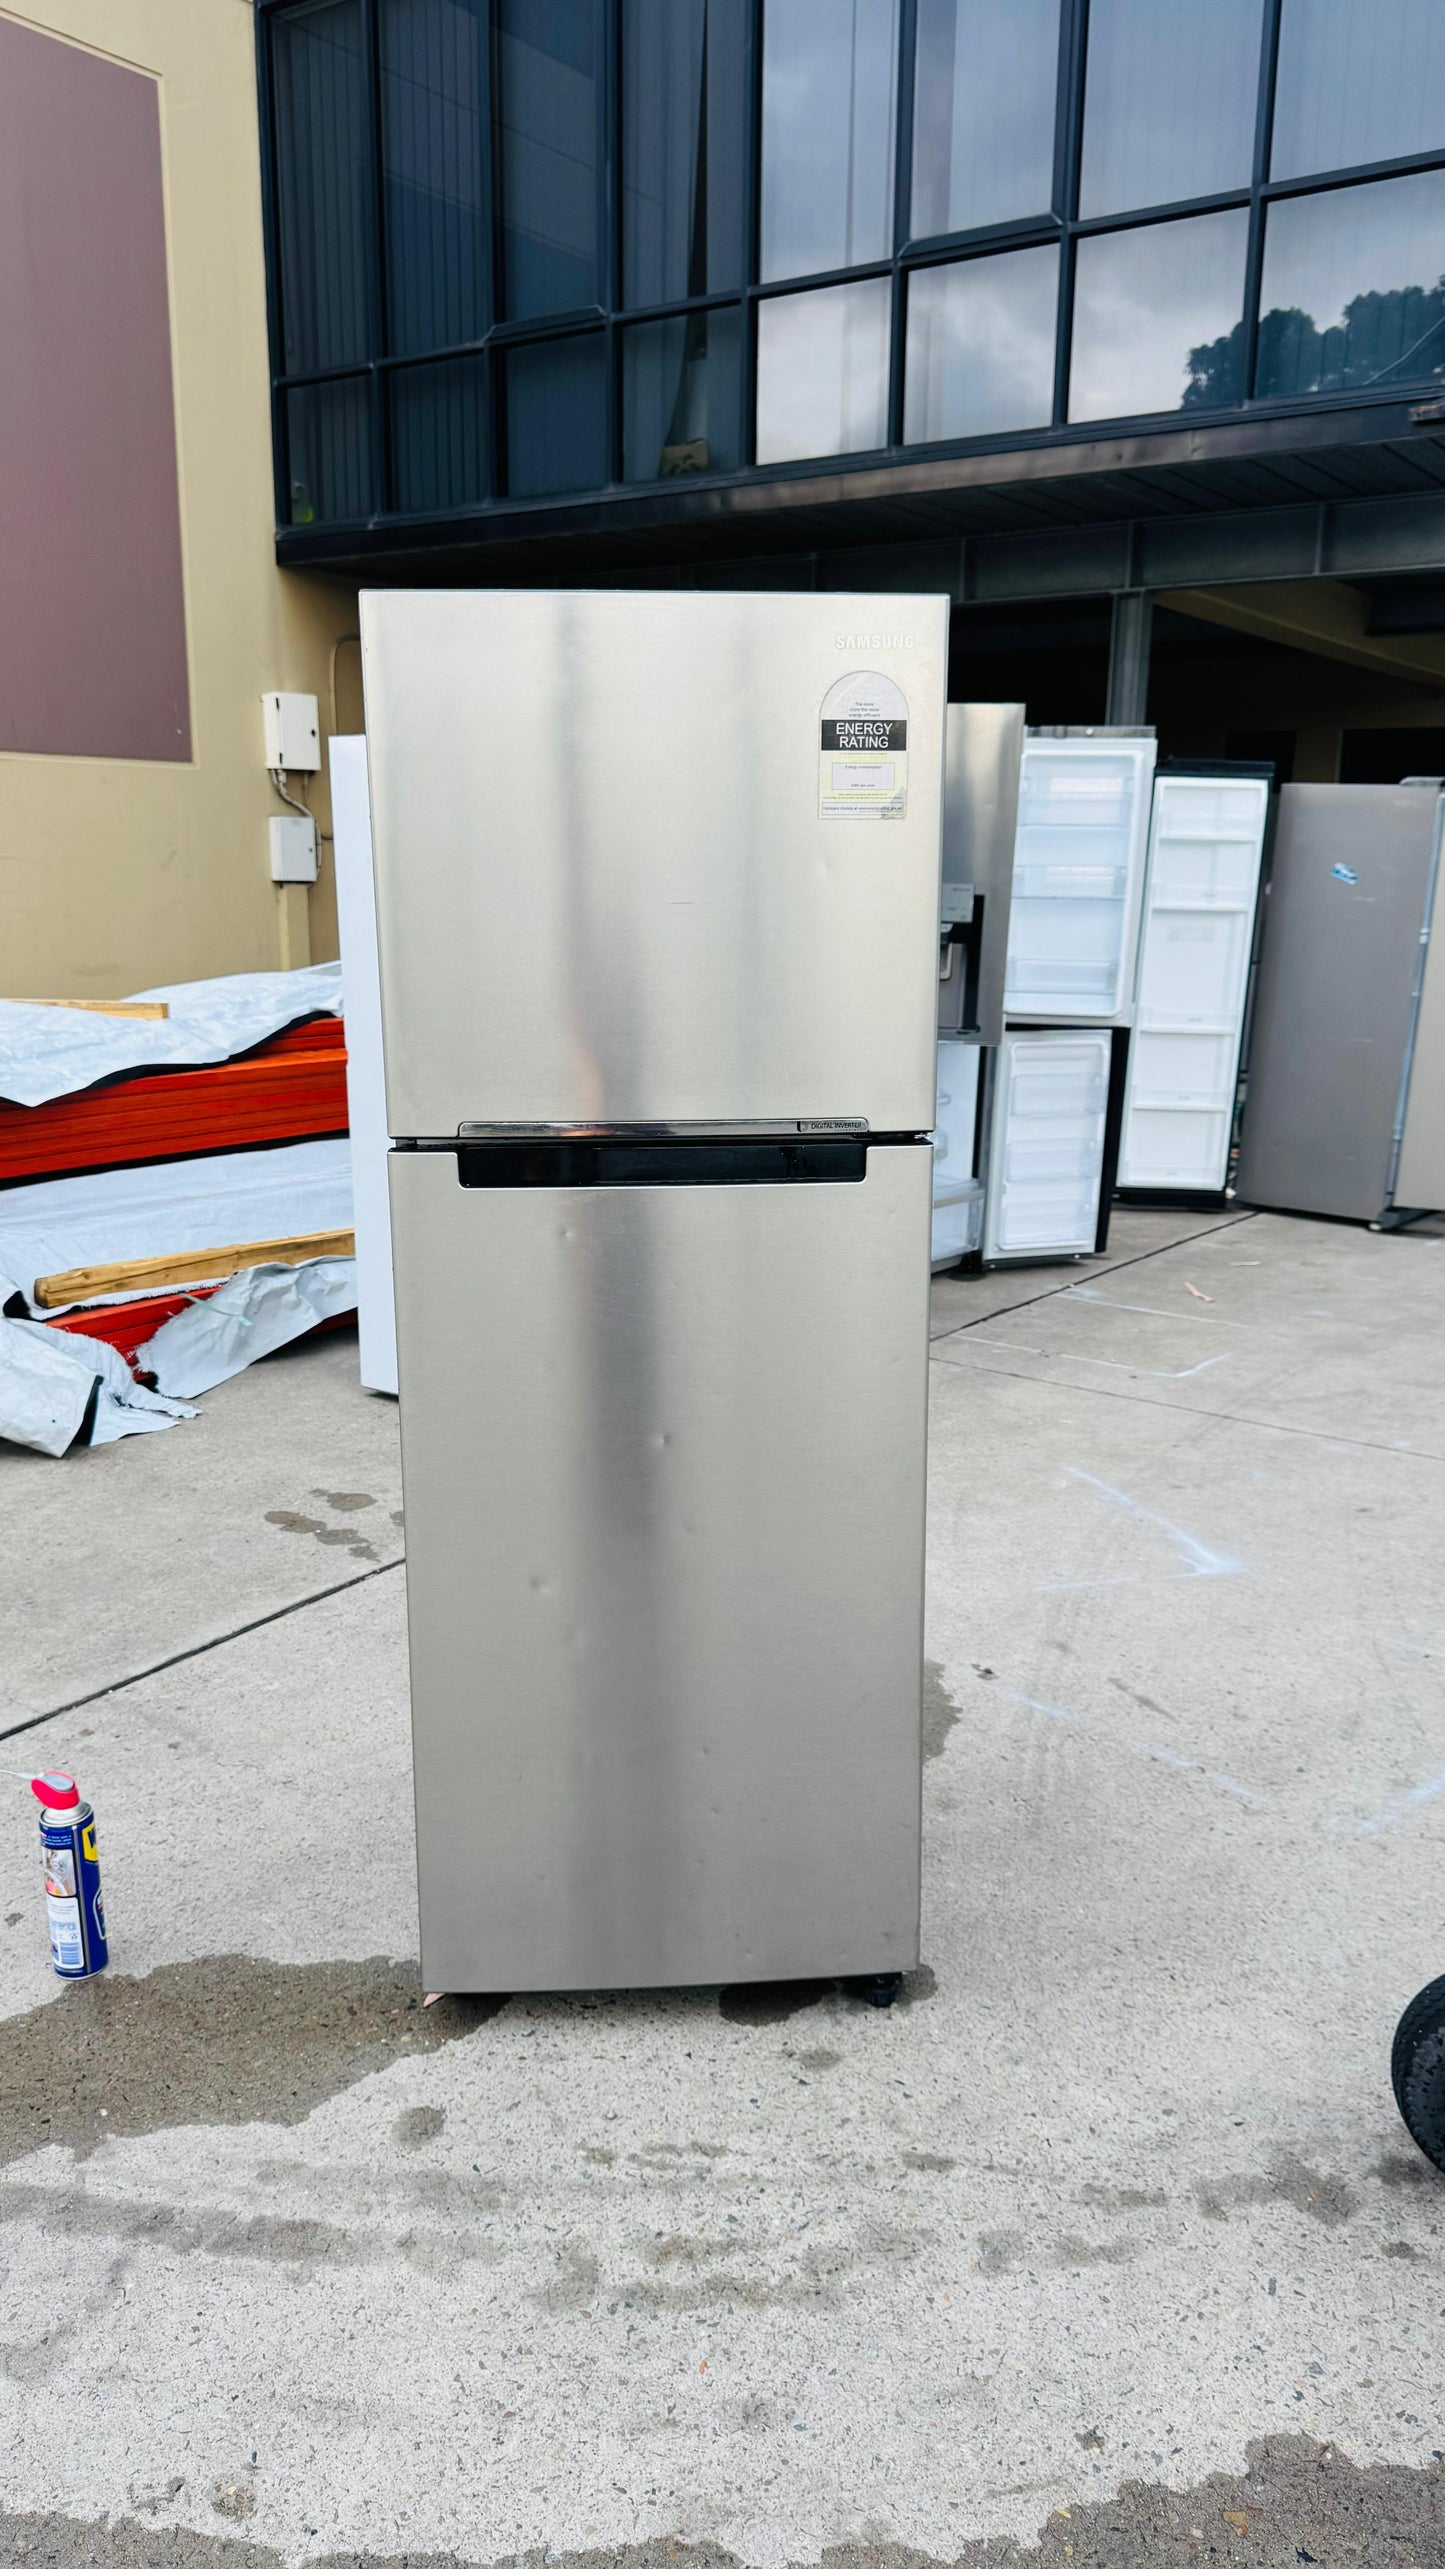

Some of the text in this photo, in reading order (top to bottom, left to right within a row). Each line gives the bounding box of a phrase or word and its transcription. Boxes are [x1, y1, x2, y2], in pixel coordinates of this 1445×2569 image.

[835, 634, 915, 649] SAMSUNG
[836, 722, 893, 736] ENERGY
[839, 736, 889, 749] RATING
